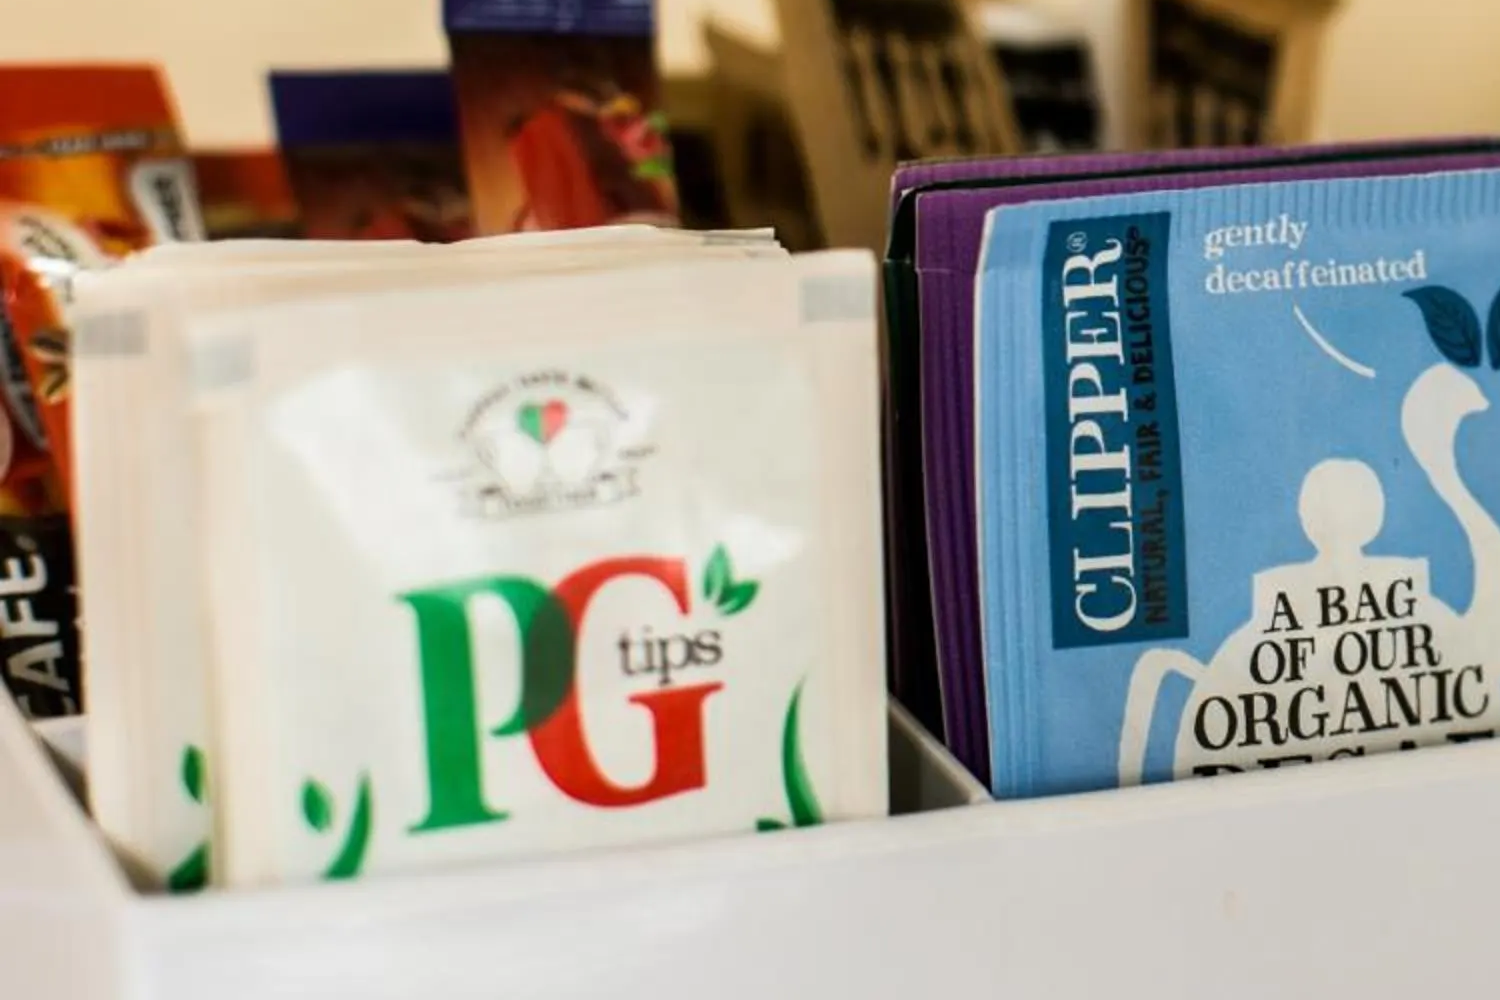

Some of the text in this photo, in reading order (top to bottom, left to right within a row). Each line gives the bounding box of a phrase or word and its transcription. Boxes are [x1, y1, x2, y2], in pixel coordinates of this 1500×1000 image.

[1203, 213, 1307, 260] gently
[1204, 249, 1428, 294] decaffeinated
[1133, 391, 1157, 412] &
[1136, 420, 1162, 482] FAIR
[1141, 488, 1170, 624] NATURAL,
[1262, 577, 1417, 633] A BAG
[1250, 624, 1442, 685] OF OUR
[396, 555, 725, 834] PG tips
[1193, 664, 1490, 751] ORGANIC
